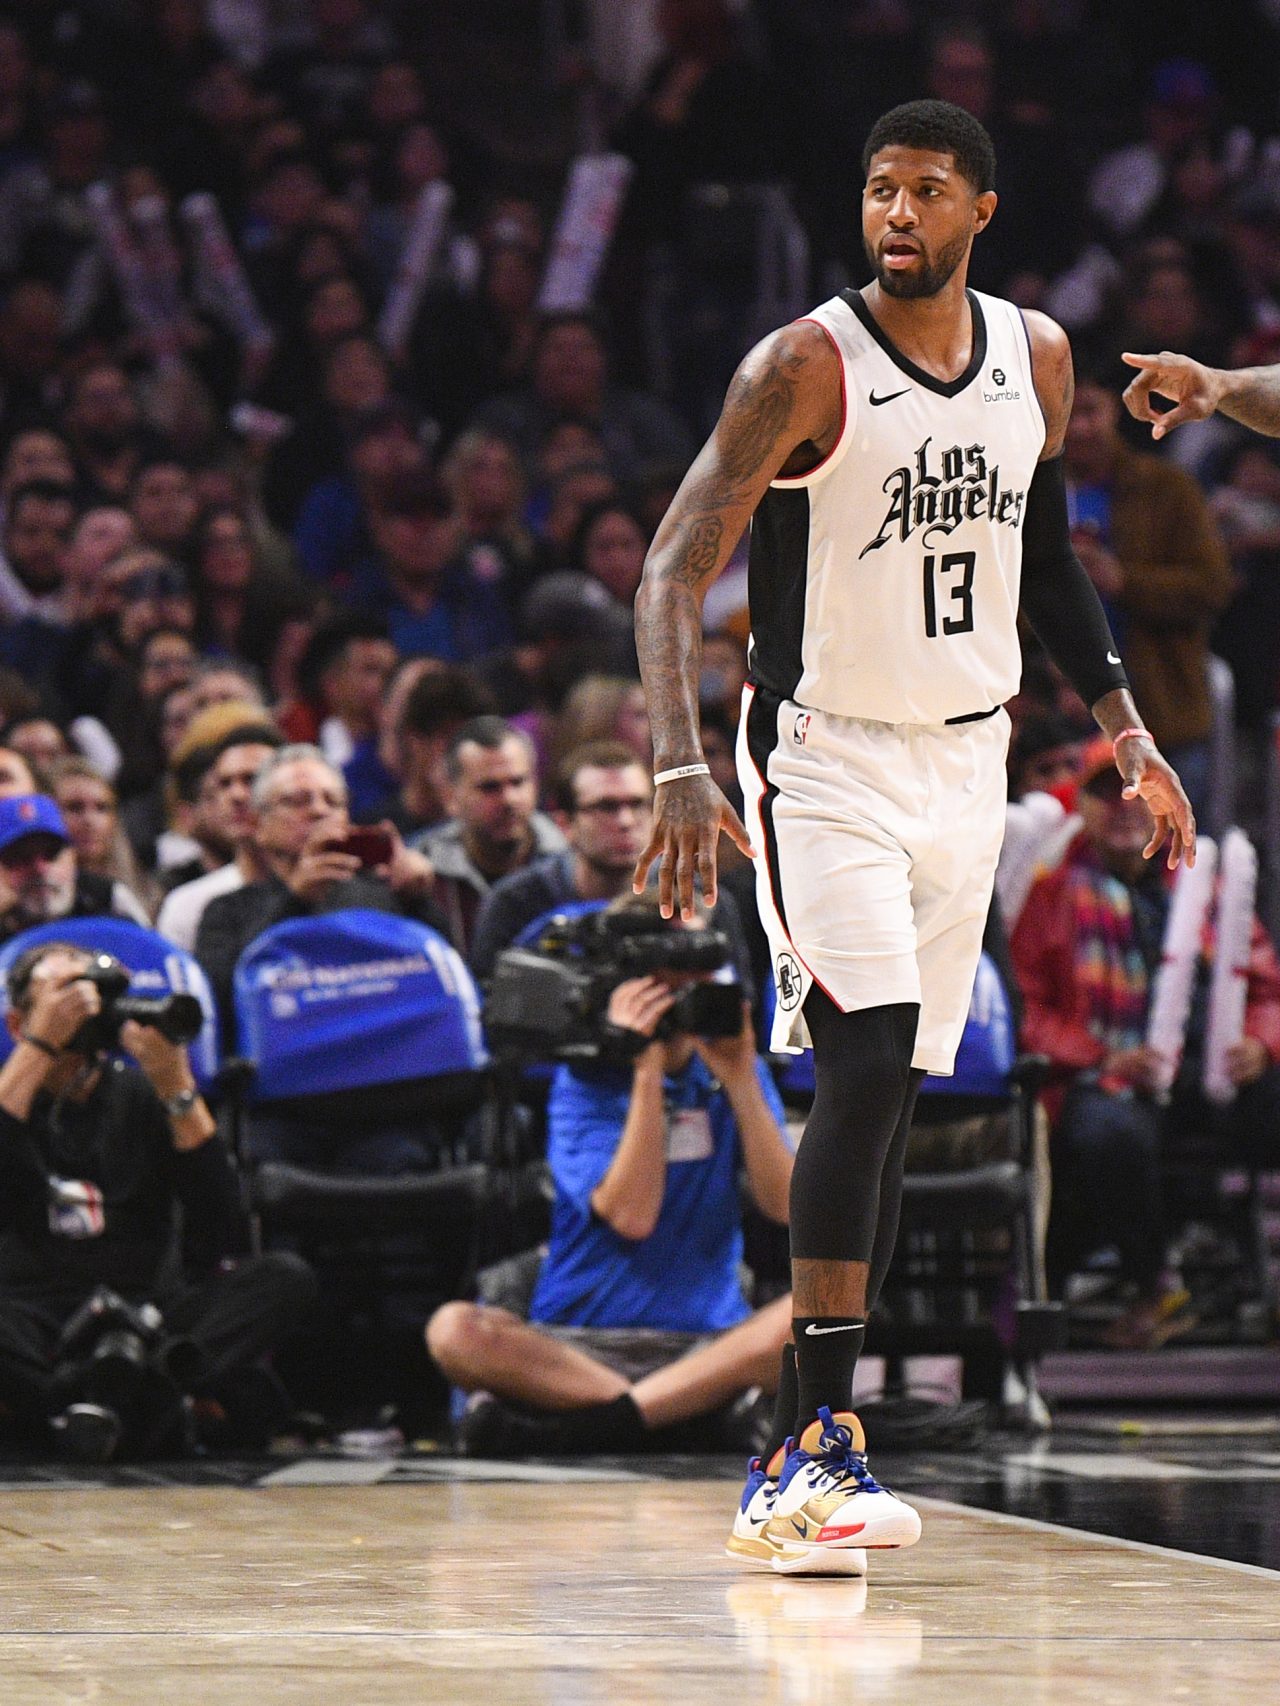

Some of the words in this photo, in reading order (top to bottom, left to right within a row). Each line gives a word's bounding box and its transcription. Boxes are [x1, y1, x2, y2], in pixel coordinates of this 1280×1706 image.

[983, 391, 1020, 403] bumble
[913, 436, 986, 490] Los
[858, 464, 1025, 560] Angeles
[923, 551, 976, 638] 13
